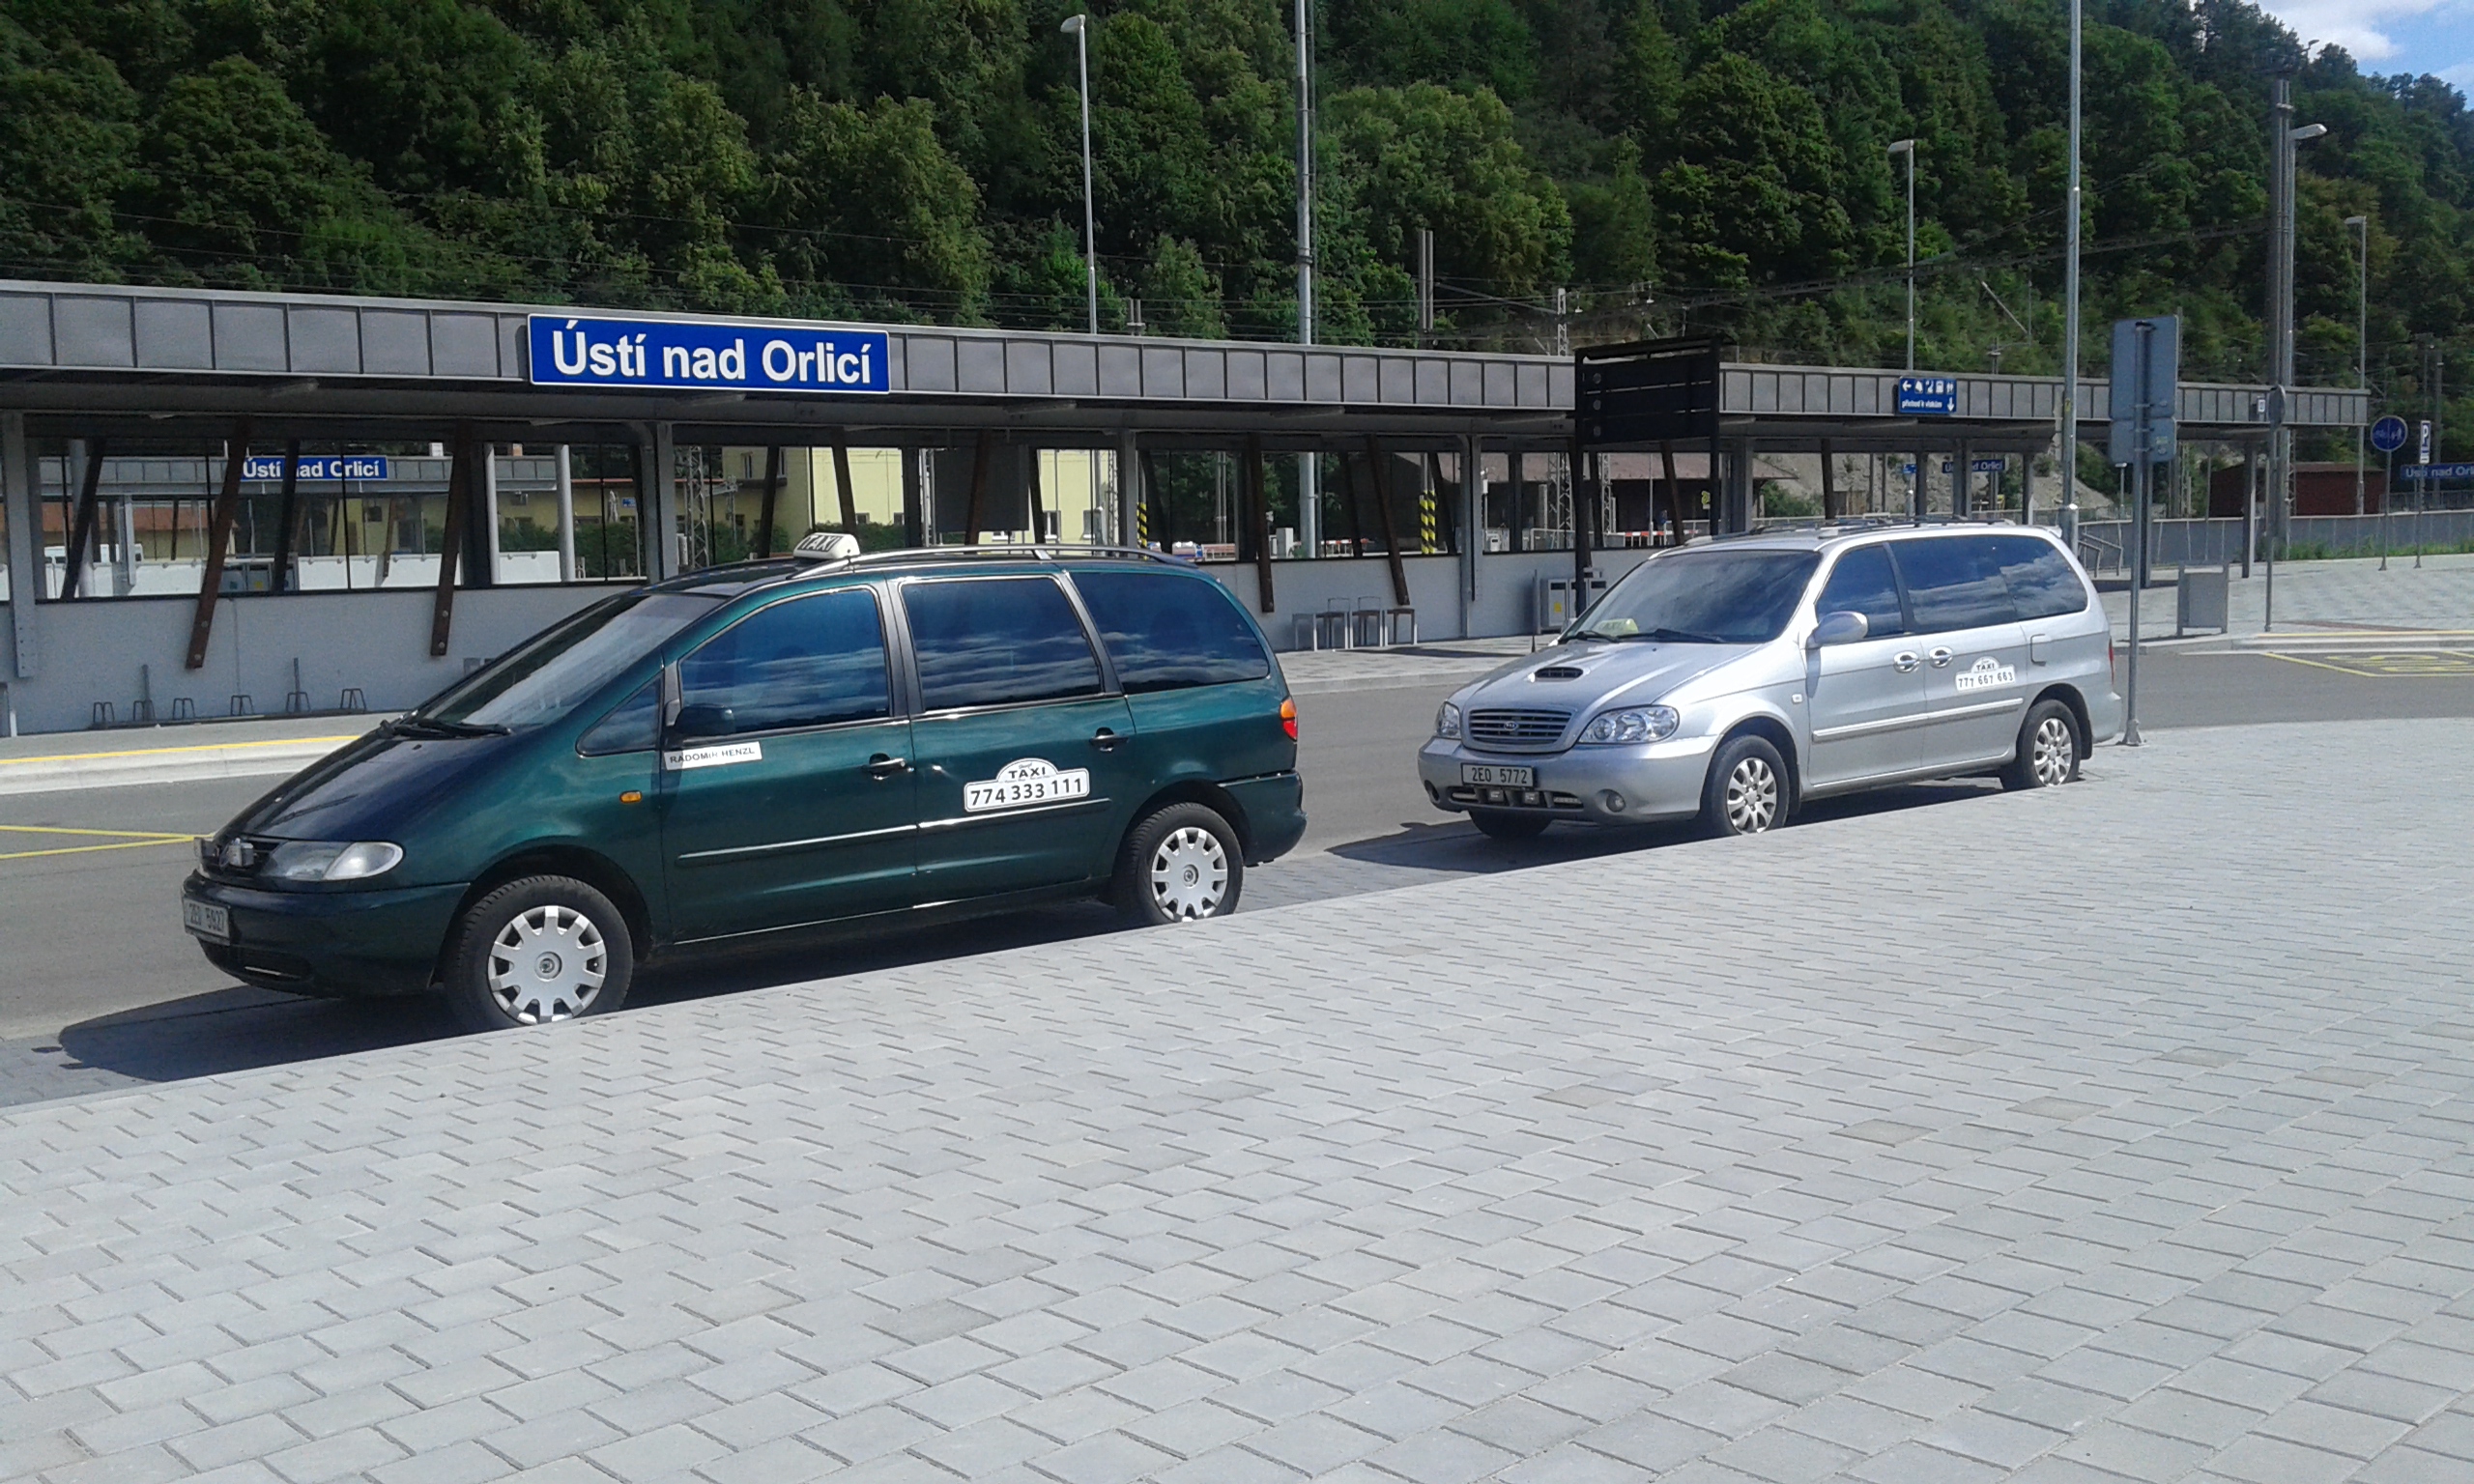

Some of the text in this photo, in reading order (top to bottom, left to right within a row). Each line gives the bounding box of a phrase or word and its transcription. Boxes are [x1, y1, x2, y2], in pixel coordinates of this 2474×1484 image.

[553, 320, 872, 384] Ústí nad Orlicí
[2422, 424, 2429, 443] P
[243, 457, 281, 477] Ústí
[296, 461, 324, 477] ad
[800, 534, 842, 552] TAXI
[1976, 662, 1995, 671] TAXI
[1958, 677, 1974, 688] 777
[1008, 766, 1046, 780] TAXI
[1499, 768, 1527, 784] 5772
[970, 787, 1006, 806] 774
[1011, 783, 1045, 801] 333
[1051, 778, 1081, 795] 111
